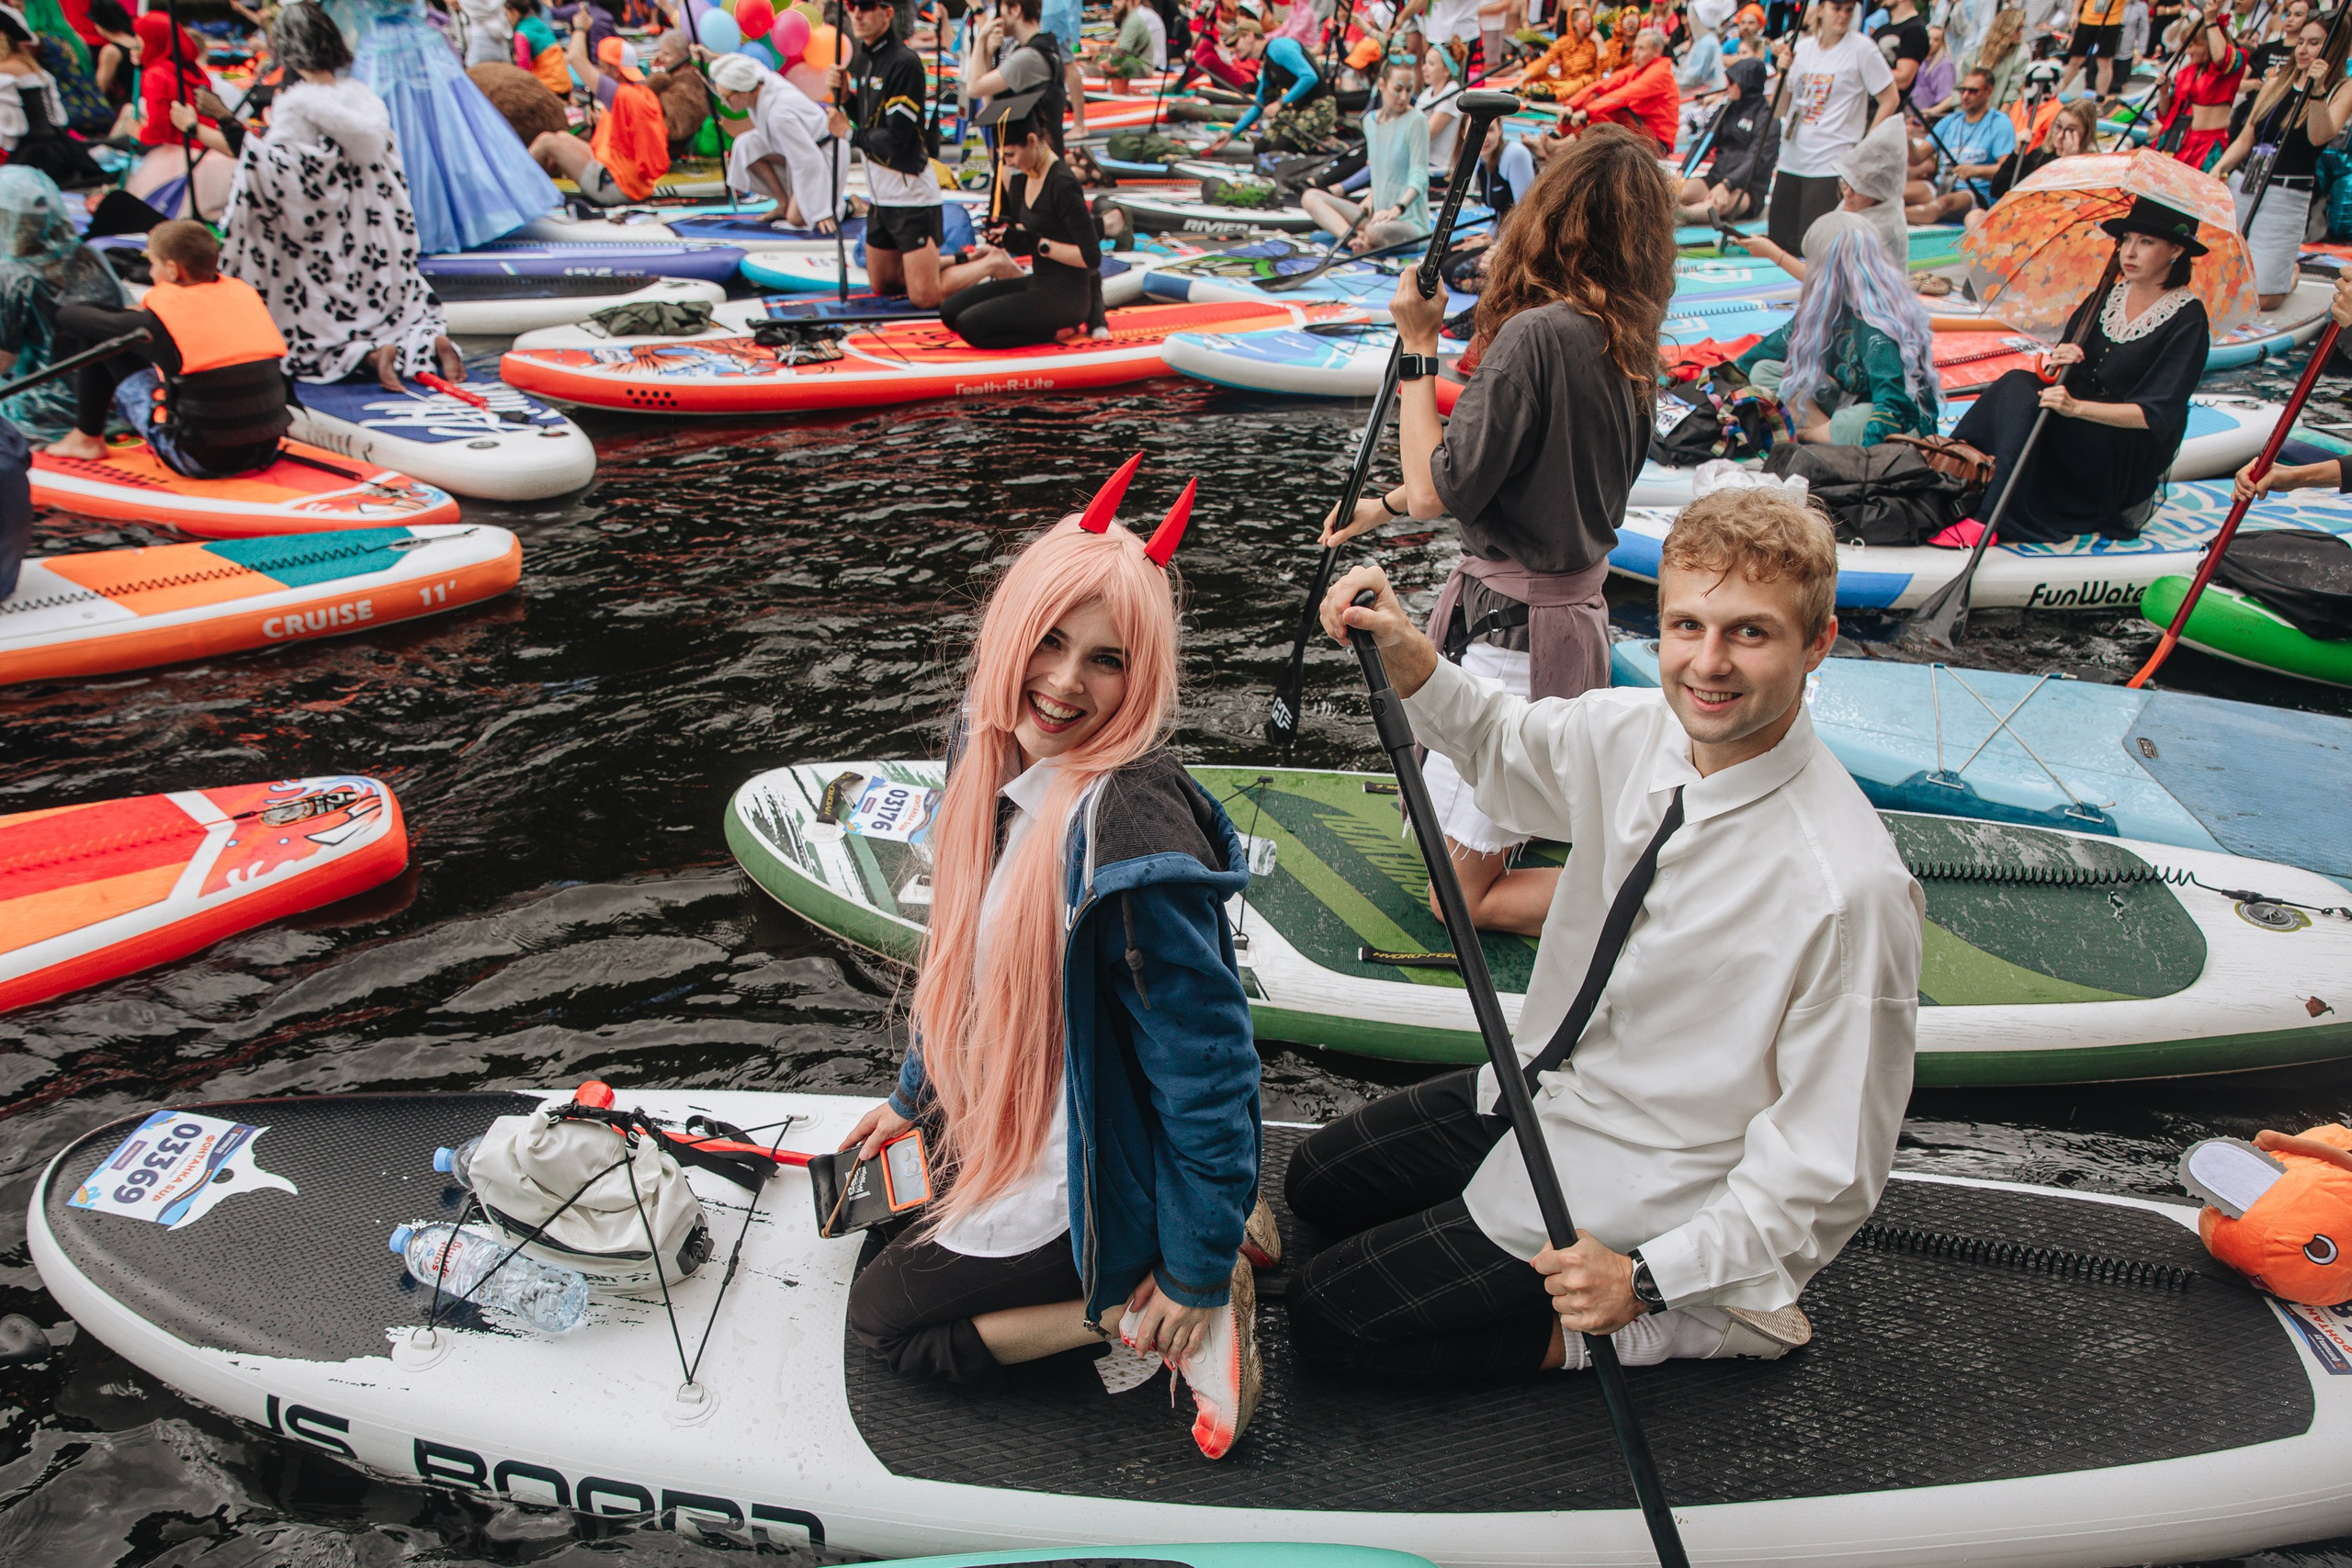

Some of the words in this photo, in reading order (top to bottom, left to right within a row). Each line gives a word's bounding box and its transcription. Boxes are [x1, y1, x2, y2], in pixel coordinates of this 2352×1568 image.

[263, 599, 374, 638] CRUISE
[871, 789, 910, 831] 03176
[113, 1123, 202, 1204] 03369
[172, 1134, 216, 1184] ФОНТАНКА
[152, 1184, 175, 1201] SUP
[2301, 1304, 2352, 1354] ФОНТАН
